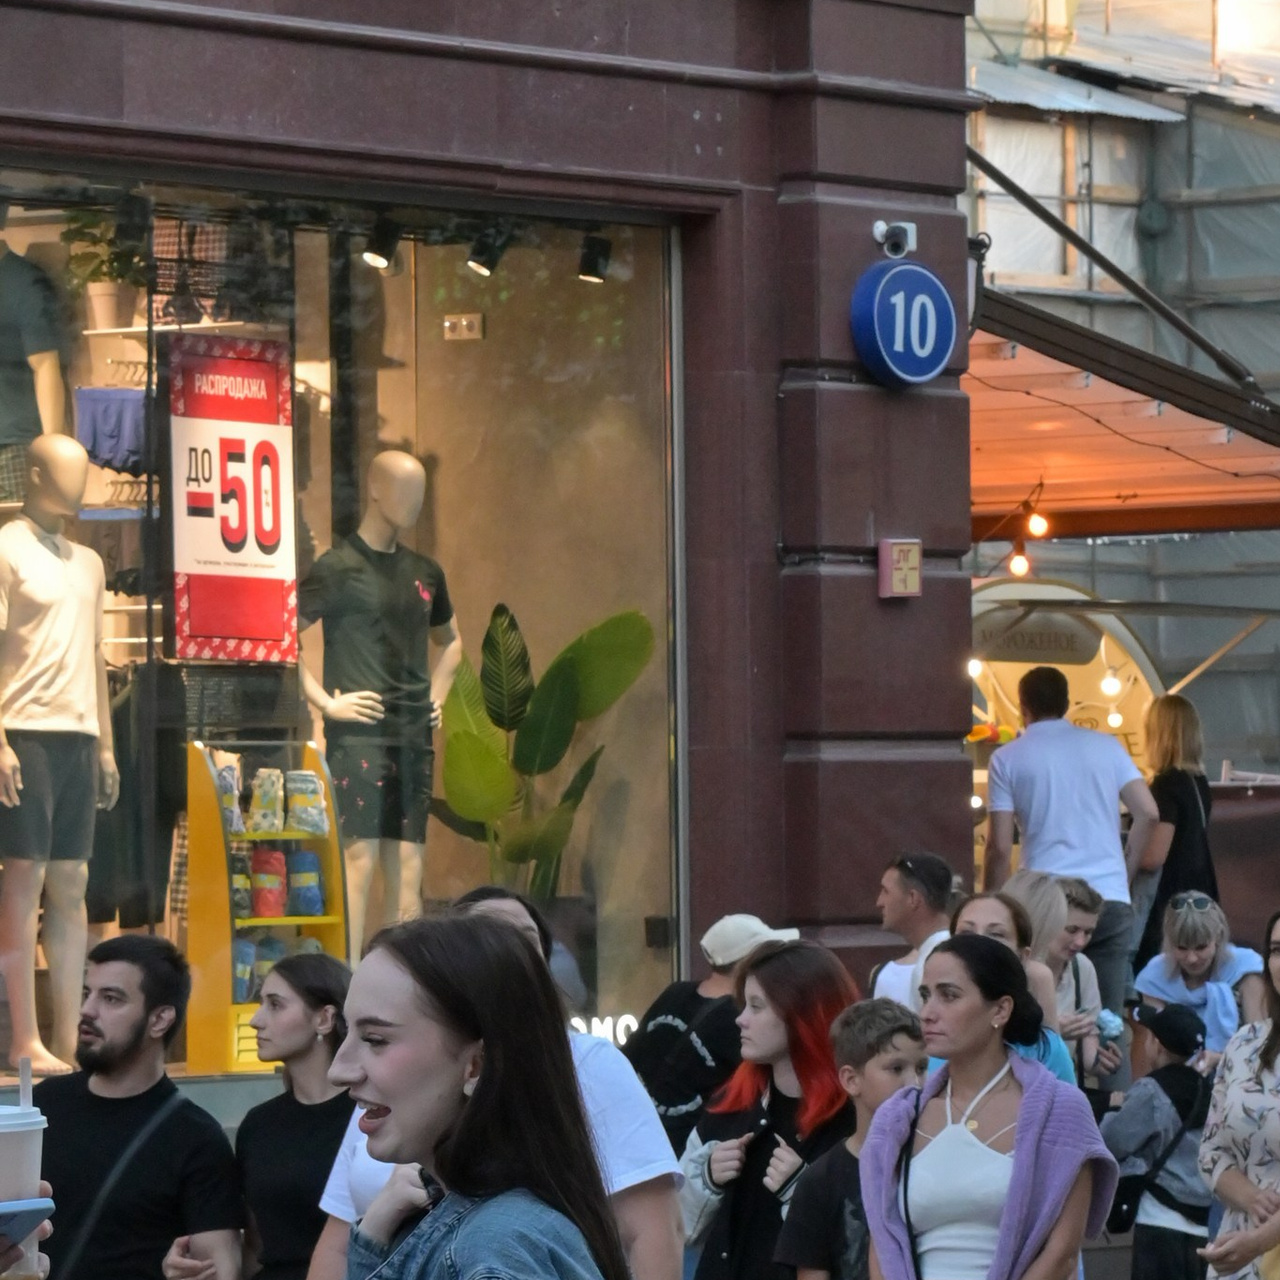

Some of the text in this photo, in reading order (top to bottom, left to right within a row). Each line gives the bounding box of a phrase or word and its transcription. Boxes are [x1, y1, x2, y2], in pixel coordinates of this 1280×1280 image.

[889, 290, 937, 358] 10
[195, 373, 268, 400] РАСПРОДАЖА
[186, 447, 213, 488] ДО
